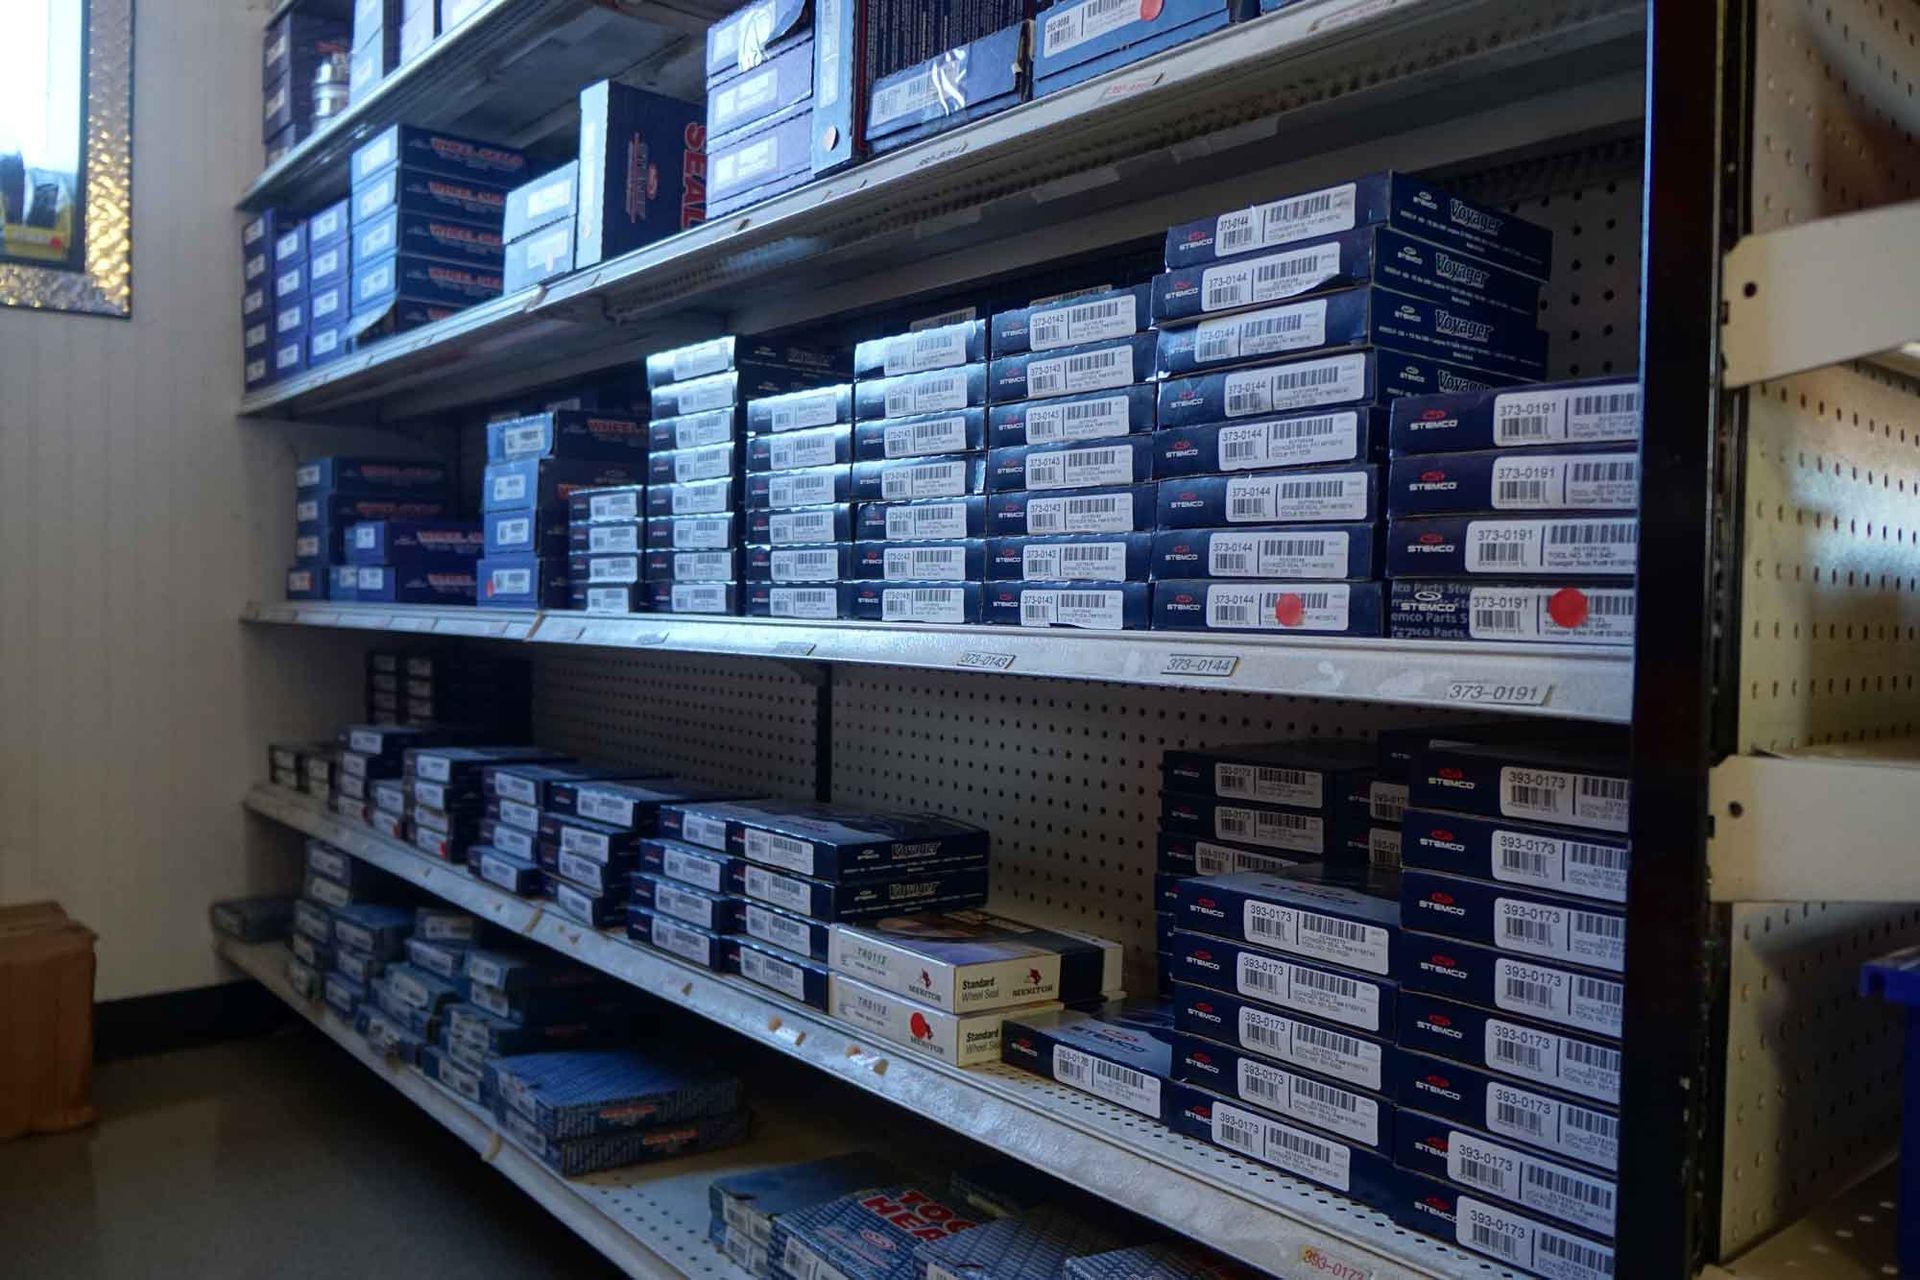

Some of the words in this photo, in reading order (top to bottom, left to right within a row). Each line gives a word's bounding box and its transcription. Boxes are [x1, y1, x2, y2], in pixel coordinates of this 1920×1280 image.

[1219, 215, 1249, 232] 373-0144
[1450, 198, 1504, 234] Voyager
[1179, 237, 1214, 251] STEMCO
[1435, 252, 1491, 286] Voyager
[1208, 272, 1248, 289] 373-0144
[1165, 287, 1199, 300] STEMCO
[1435, 309, 1495, 340] Voyager
[1228, 380, 1267, 395] 373-0144
[1170, 398, 1204, 408] STEMCO
[1500, 402, 1556, 416] 373-0191
[1410, 420, 1459, 430] STEMCO
[1222, 429, 1263, 442] 373-0144
[1166, 449, 1199, 458] STEMCO
[1498, 467, 1555, 480] 373-0191
[1232, 487, 1271, 498] 373-0144
[1408, 482, 1457, 492] STEMCO
[1170, 500, 1204, 508] STEMCO
[1477, 529, 1533, 541] 373-0191
[1213, 542, 1253, 552] 373-0144
[1407, 544, 1455, 553] STEMCO
[1165, 553, 1198, 562] STEMCO
[1214, 594, 1254, 604] 373-0144
[1473, 597, 1529, 609] 373-0191
[1167, 603, 1200, 611] STEMCO
[1400, 602, 1456, 612] STEMCO
[1426, 612, 1458, 624] Parts
[960, 653, 1008, 668] 373-0143
[1166, 657, 1230, 672] 373-0144
[1449, 684, 1537, 700] 373-0191
[1427, 776, 1476, 789] STEMCO
[1508, 771, 1566, 787] 393-0173
[1419, 837, 1466, 853] STEMCO
[1500, 835, 1556, 855] 393-0173
[1190, 904, 1225, 918] STEMCO
[1251, 904, 1292, 922] 393-0173
[1418, 899, 1466, 916] STEMCO
[1503, 903, 1561, 924] 393-0173
[1186, 956, 1220, 971] STEMCO
[1243, 956, 1284, 976] 393-0173
[1420, 961, 1468, 979] STEMCO
[962, 976, 995, 990] Standard
[1505, 964, 1562, 987] 393-0173
[908, 984, 942, 1003] MERITOR
[1012, 983, 1053, 998] MERITOR
[1187, 1007, 1222, 1024] STEMCO
[1245, 1011, 1286, 1032] 393-0173
[966, 1028, 999, 1043] Standard
[1416, 1020, 1464, 1039] STEMCO
[1494, 1025, 1551, 1050] 393-0173
[1185, 1058, 1220, 1074] STEMCO
[1243, 1063, 1284, 1086] 393-0173
[1415, 1081, 1462, 1101] STEMCO
[1495, 1089, 1552, 1115] 393-0173
[1219, 1112, 1259, 1135] 393-0173
[1459, 1144, 1513, 1172] 393-0173
[1470, 1209, 1526, 1239] 393-0173
